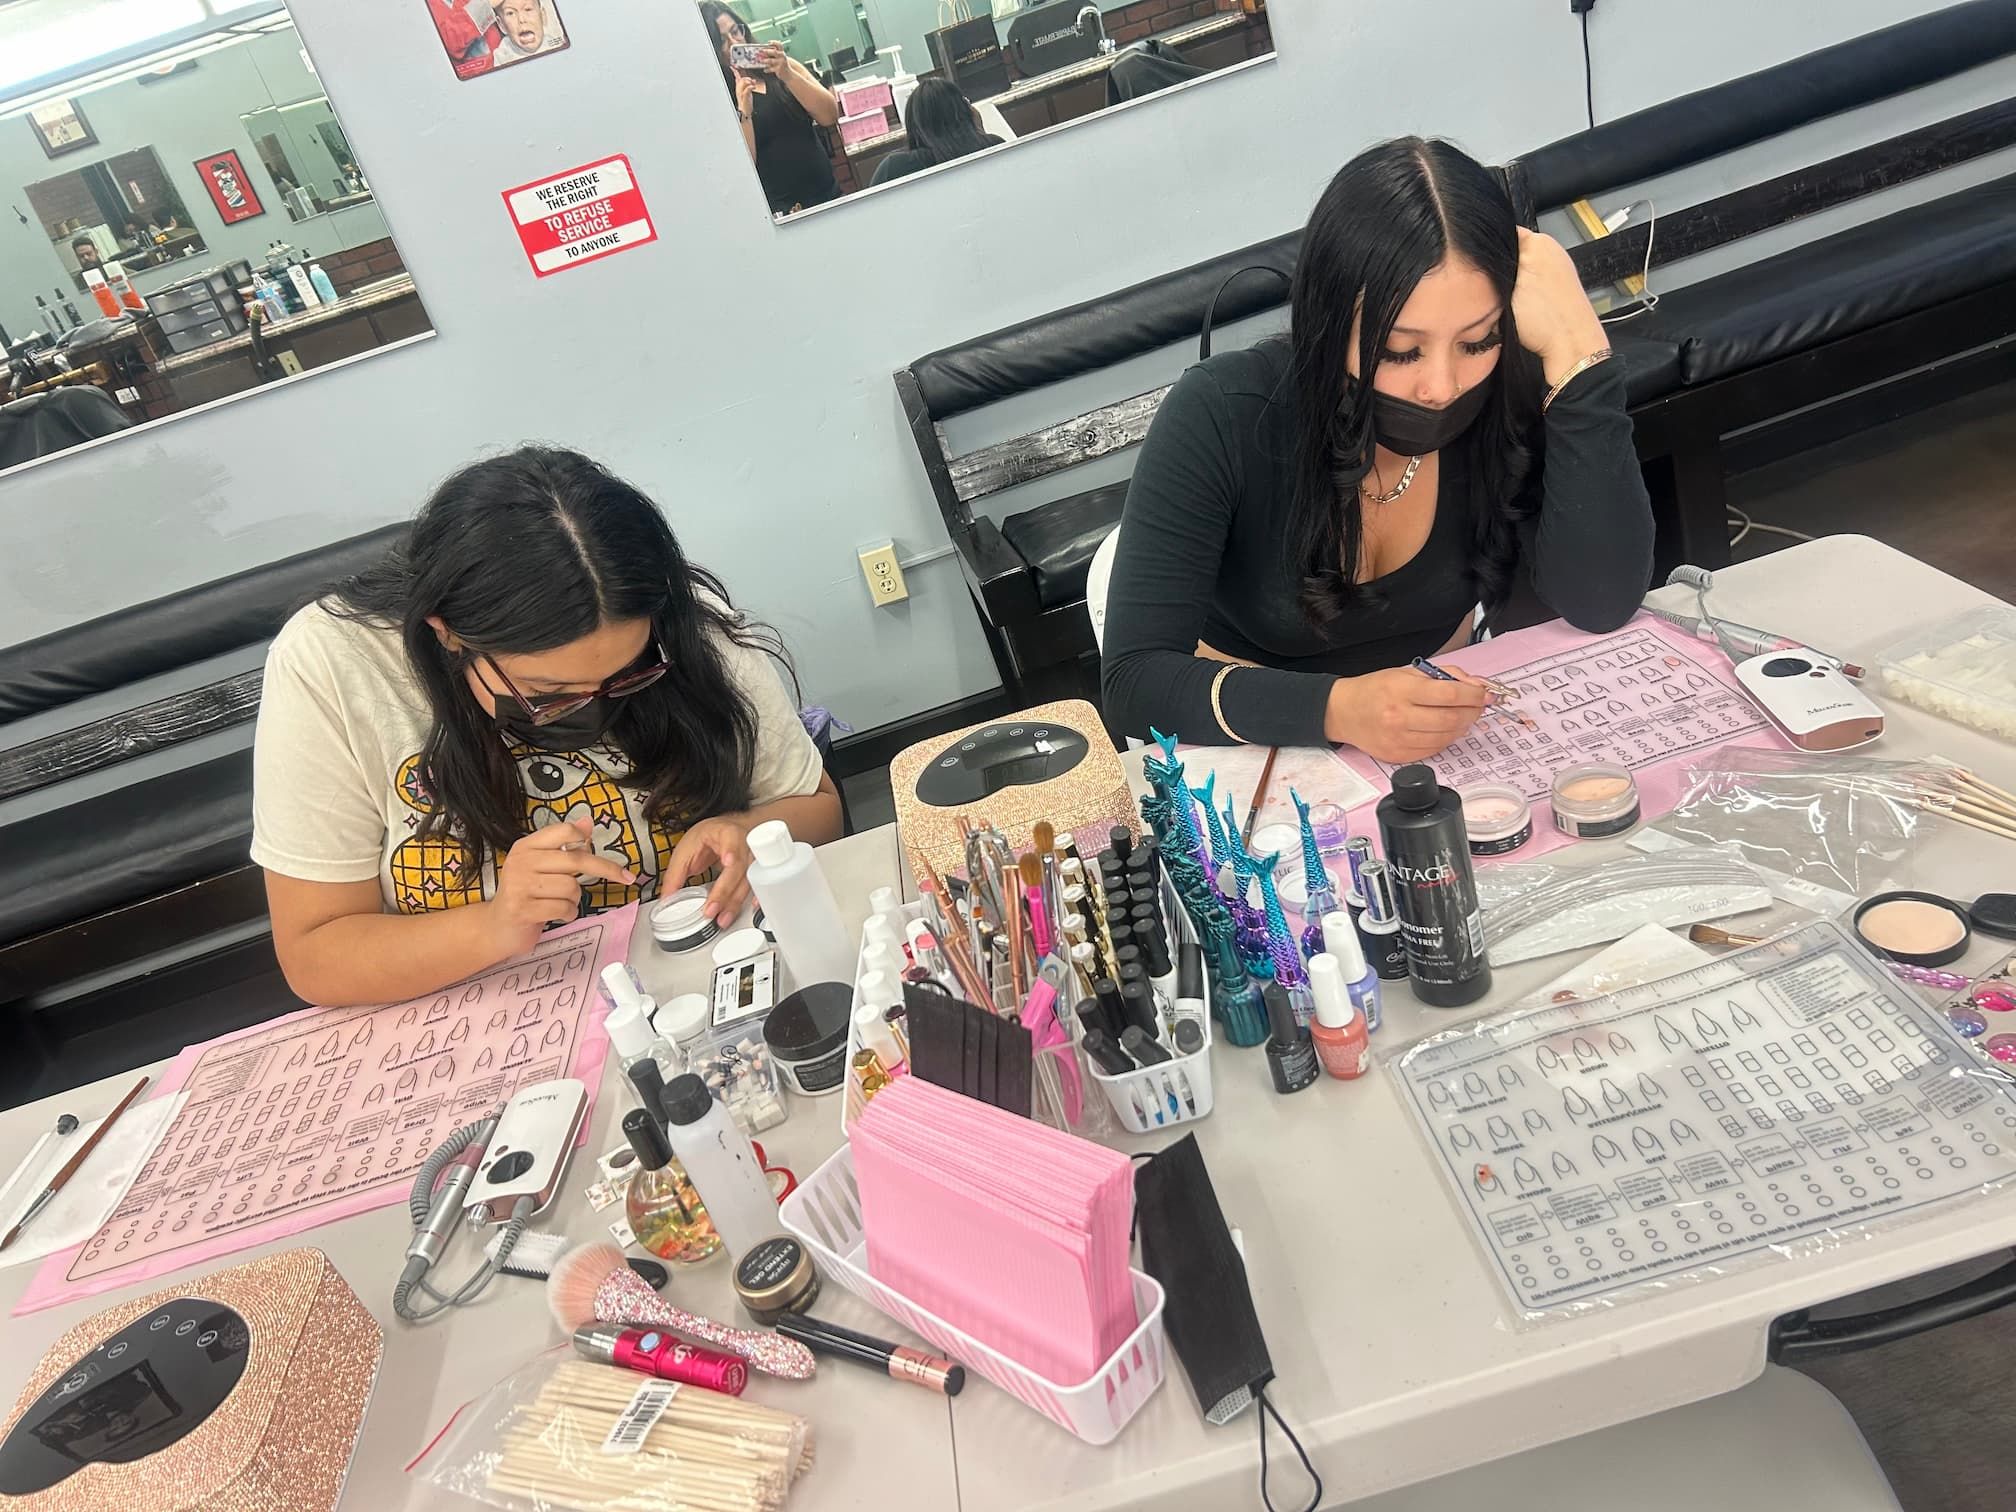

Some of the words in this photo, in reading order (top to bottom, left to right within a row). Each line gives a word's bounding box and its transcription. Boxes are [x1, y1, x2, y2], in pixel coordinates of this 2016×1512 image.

[536, 187, 554, 201] WE
[554, 172, 600, 197] RESERVE
[545, 196, 567, 211] THE
[568, 186, 599, 205] RIGHT
[544, 216, 563, 232] TO
[563, 199, 614, 226] REFUSE
[557, 215, 612, 243] SERVICE
[565, 246, 579, 258] TO
[581, 232, 621, 254] ANYONE
[1401, 921, 1444, 935] onomer
[764, 1244, 794, 1271] EXTEND
[748, 1271, 765, 1284] GEL
